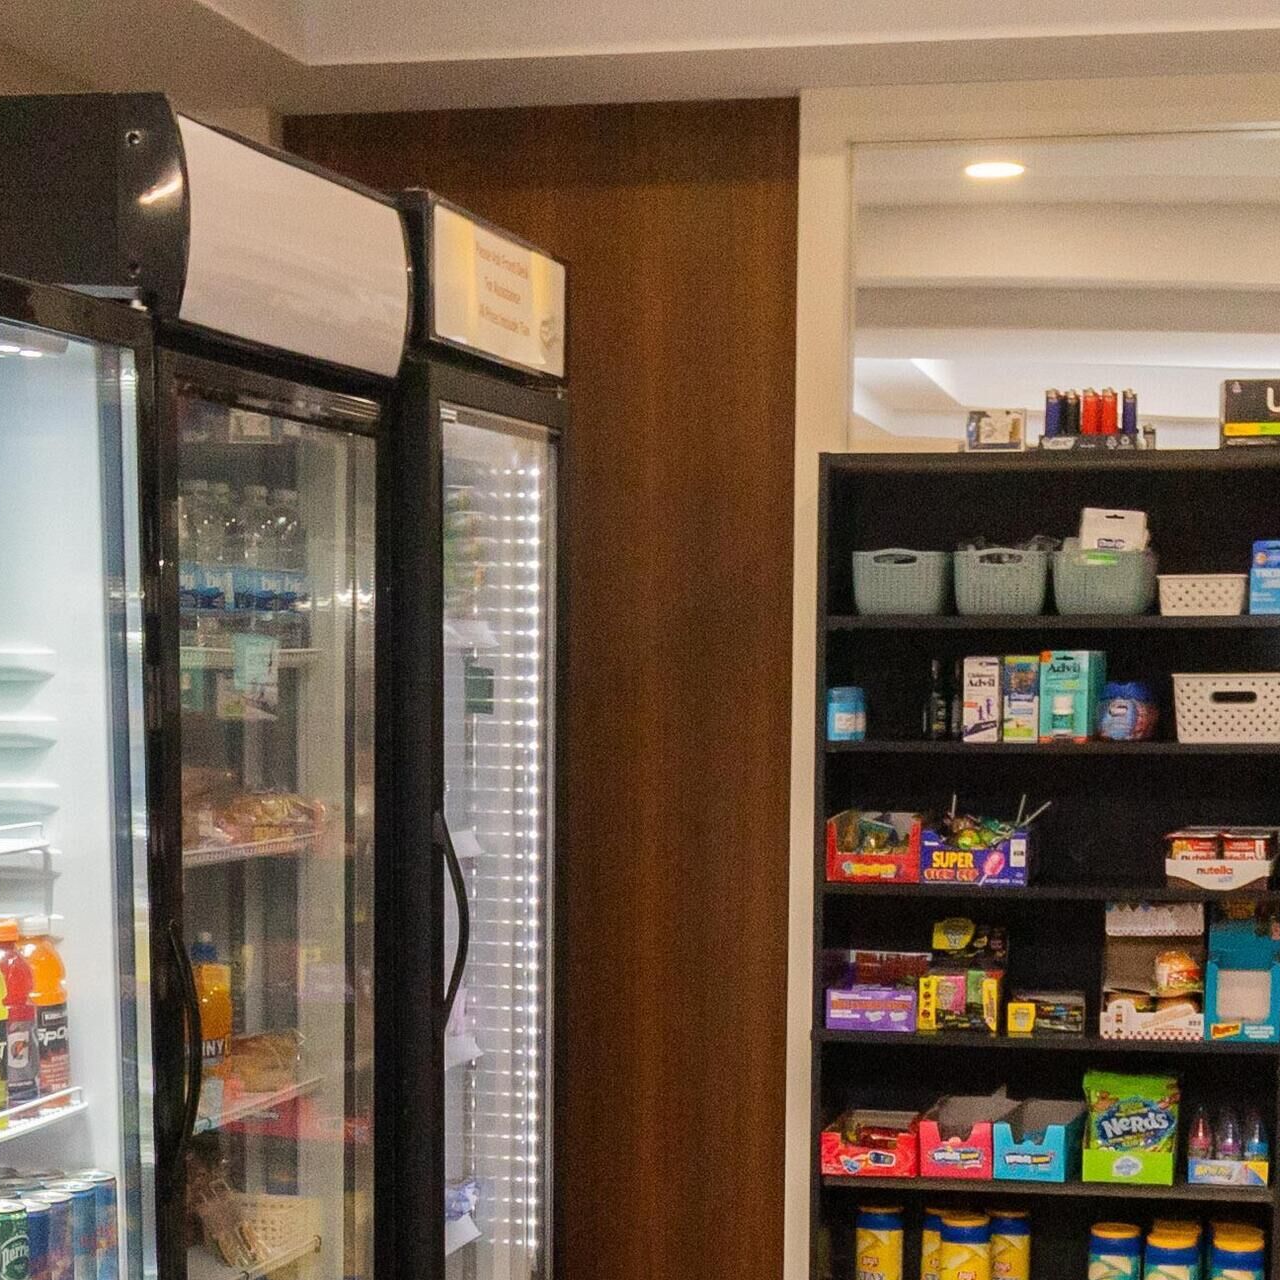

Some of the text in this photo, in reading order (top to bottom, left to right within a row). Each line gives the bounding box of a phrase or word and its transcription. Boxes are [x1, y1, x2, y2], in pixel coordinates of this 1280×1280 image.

[1048, 662, 1080, 674] Advil
[968, 679, 995, 688] Advil
[932, 851, 974, 868] SUPER
[1196, 865, 1233, 875] nutella
